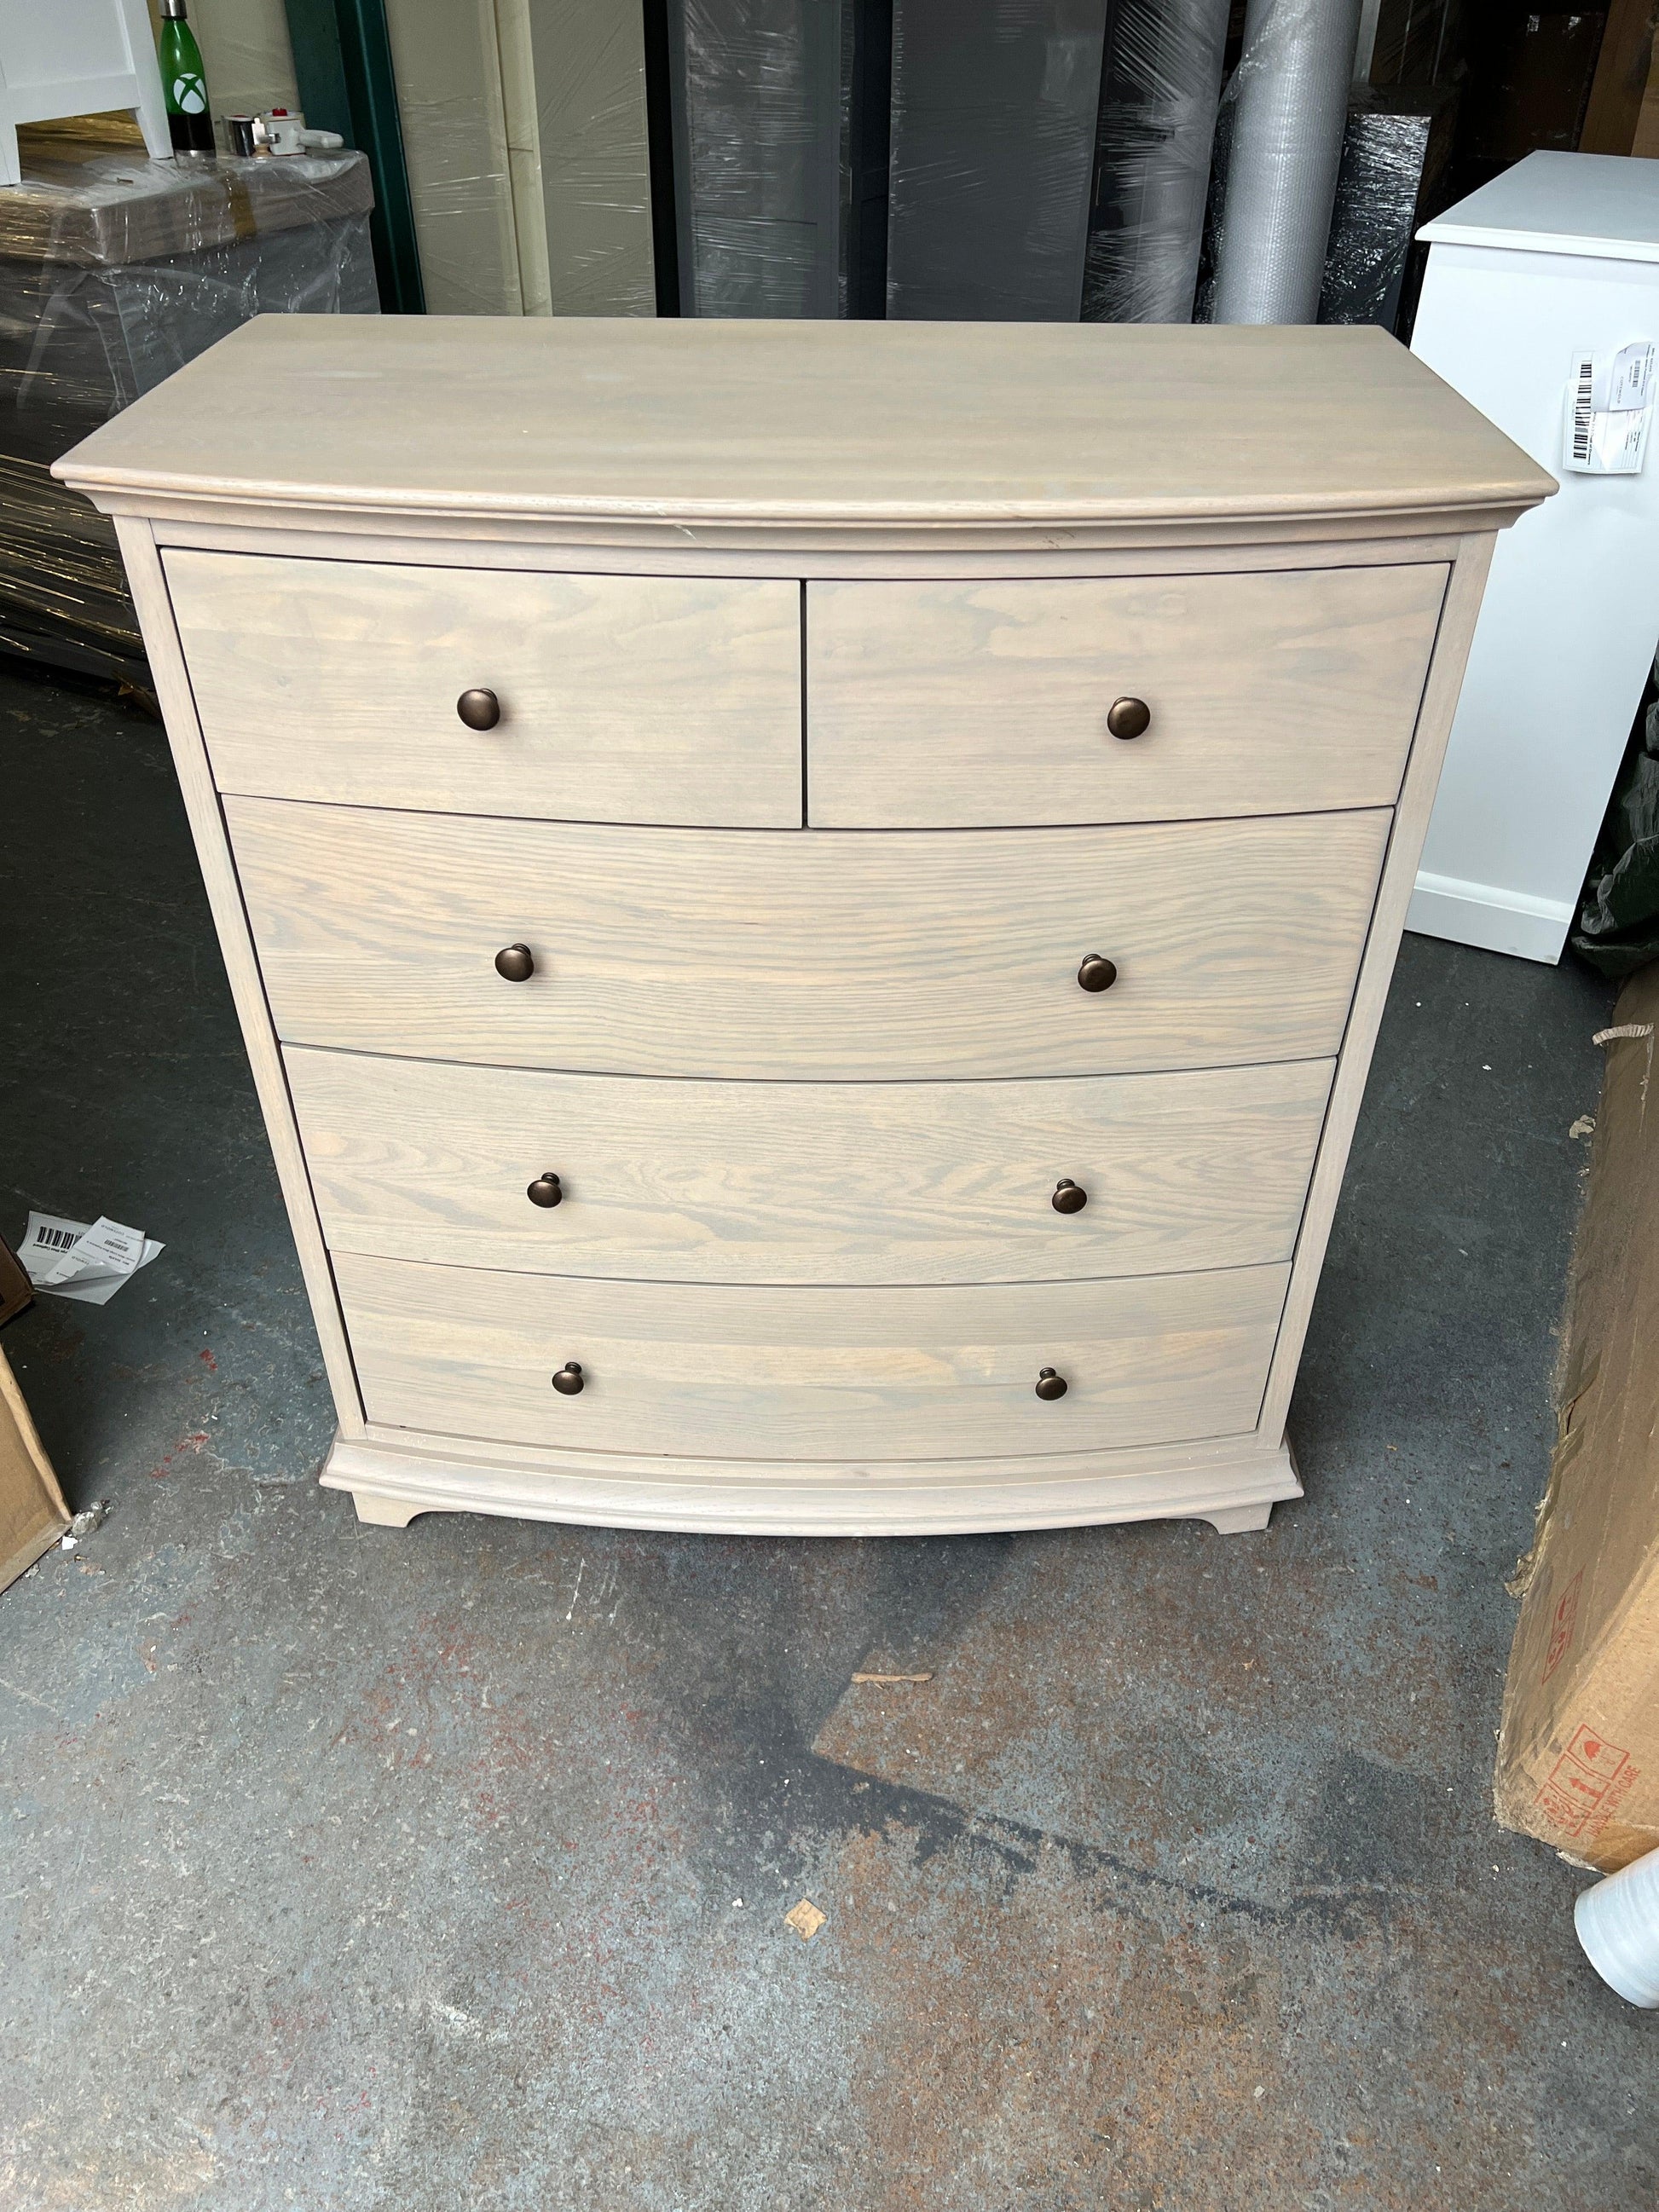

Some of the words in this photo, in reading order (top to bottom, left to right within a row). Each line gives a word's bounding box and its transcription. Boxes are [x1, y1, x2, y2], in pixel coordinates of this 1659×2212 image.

[1587, 1805, 1614, 1839] HANDLE
[1604, 1785, 1627, 1810] WITH
[1617, 1764, 1641, 1790] CARE
